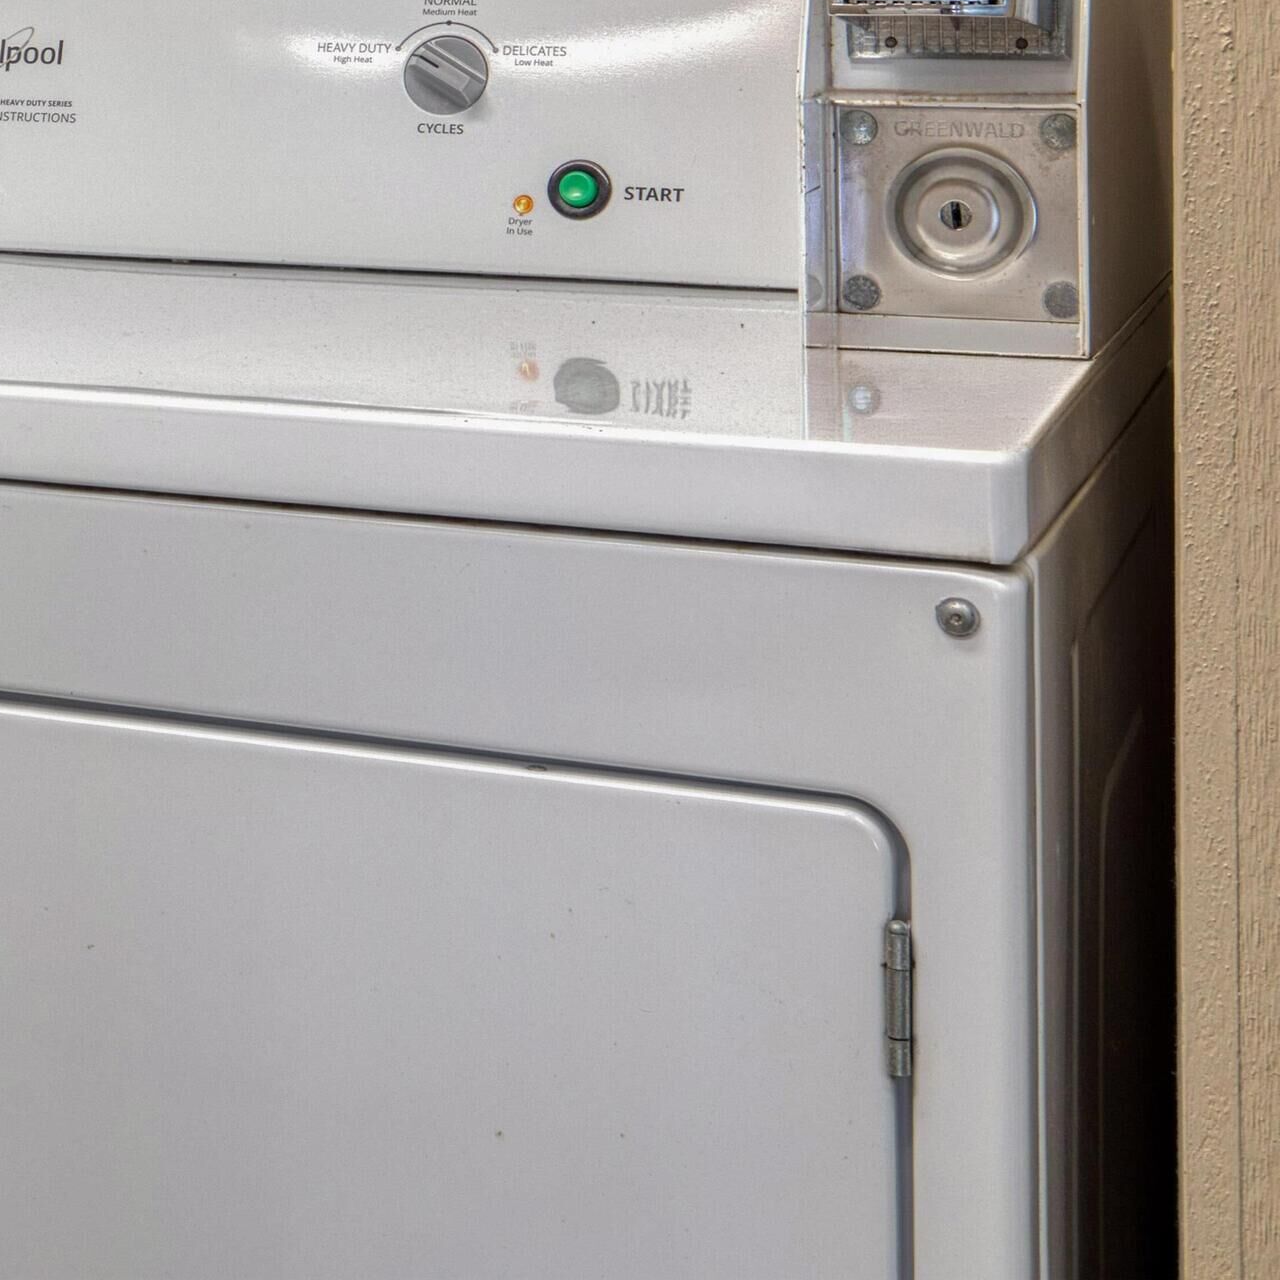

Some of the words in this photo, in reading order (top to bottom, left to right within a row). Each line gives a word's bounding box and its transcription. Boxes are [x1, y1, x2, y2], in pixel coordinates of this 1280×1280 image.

[422, 8, 456, 16] Medium
[457, 8, 477, 16] Heat
[317, 42, 355, 53] HEAVY
[359, 43, 392, 54] DUTY
[502, 45, 568, 57] DELICATES
[333, 55, 351, 64] High
[354, 55, 372, 63] Heat
[514, 58, 531, 67] Low
[533, 59, 553, 67] Heat
[0, 98, 25, 106] HEAVY
[26, 99, 47, 107] DUTY
[48, 100, 73, 108] SERIES
[417, 123, 464, 135] CYCLES
[894, 121, 1025, 138] GREENWALD
[623, 186, 685, 202] START
[508, 217, 533, 227] Dryer
[506, 227, 515, 235] In
[516, 227, 533, 236] Use
